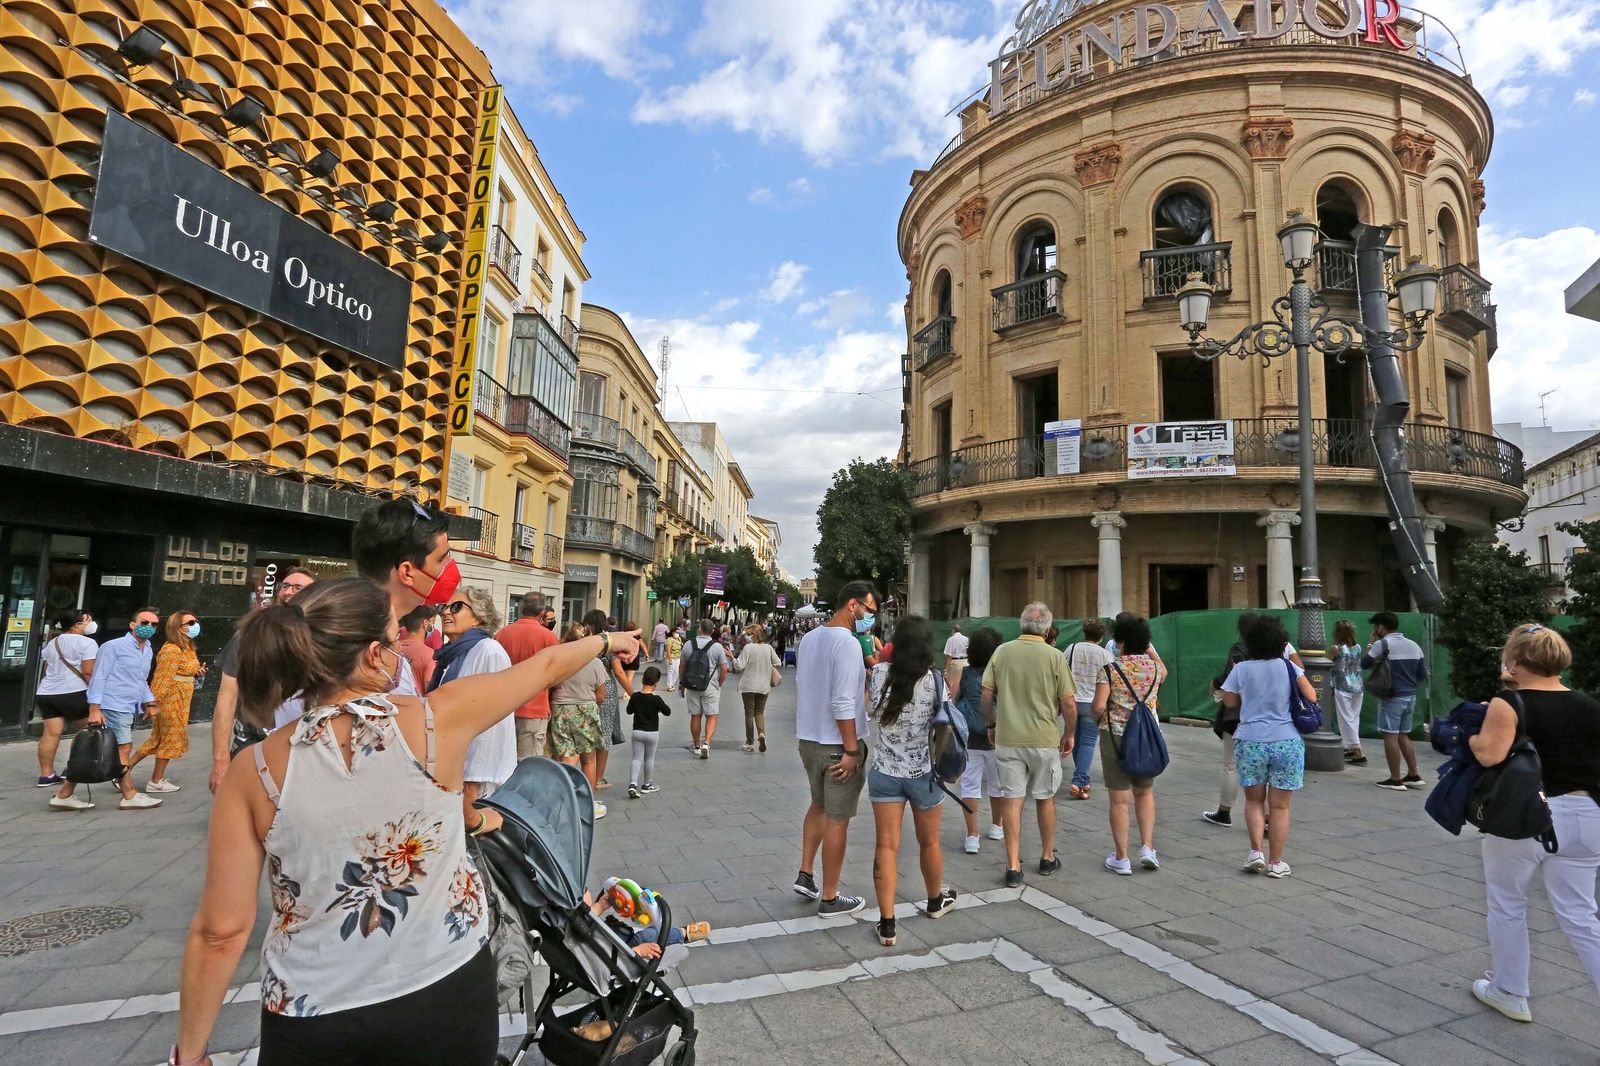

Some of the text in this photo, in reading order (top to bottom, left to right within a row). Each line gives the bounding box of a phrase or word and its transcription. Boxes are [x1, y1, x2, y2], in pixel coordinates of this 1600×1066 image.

[986, 0, 1413, 118] FUNDADOR
[470, 89, 498, 230] ULLOA
[174, 194, 373, 321] Ulloa Optico
[451, 253, 482, 431] OPTICO
[1165, 426, 1225, 443] Tess
[163, 561, 248, 586] OPTICO
[168, 535, 248, 563] ULLOA
